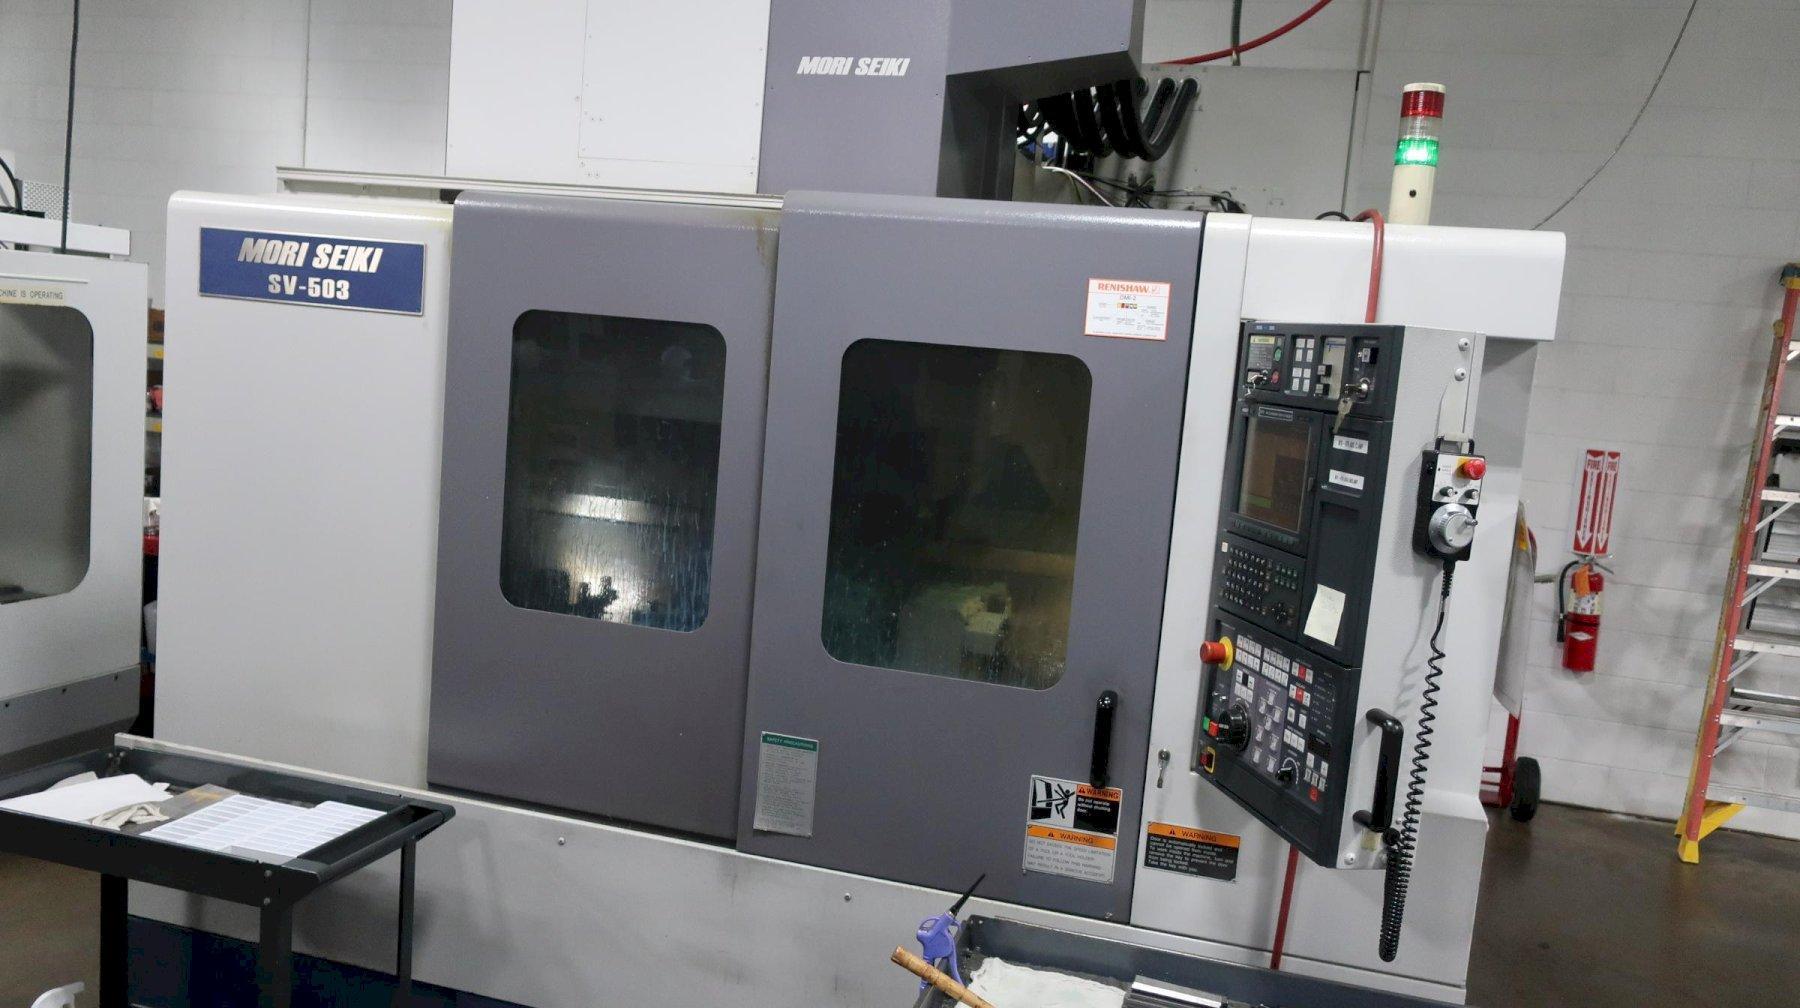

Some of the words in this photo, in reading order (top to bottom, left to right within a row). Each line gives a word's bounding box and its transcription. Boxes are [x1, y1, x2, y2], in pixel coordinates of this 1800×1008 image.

[797, 56, 853, 75] MORI
[855, 57, 910, 76] SEIKI
[238, 238, 309, 267] MORI
[312, 243, 383, 273] SEIKI
[268, 274, 350, 300] SV-503
[1098, 283, 1148, 293] RENISHAW
[21, 290, 26, 298] IS
[30, 291, 63, 300] OPERATING
[1588, 460, 1601, 470] FIRE
[1087, 789, 1119, 799] WARNING
[1059, 833, 1093, 843] WARNING
[1181, 830, 1216, 841] WARNING
